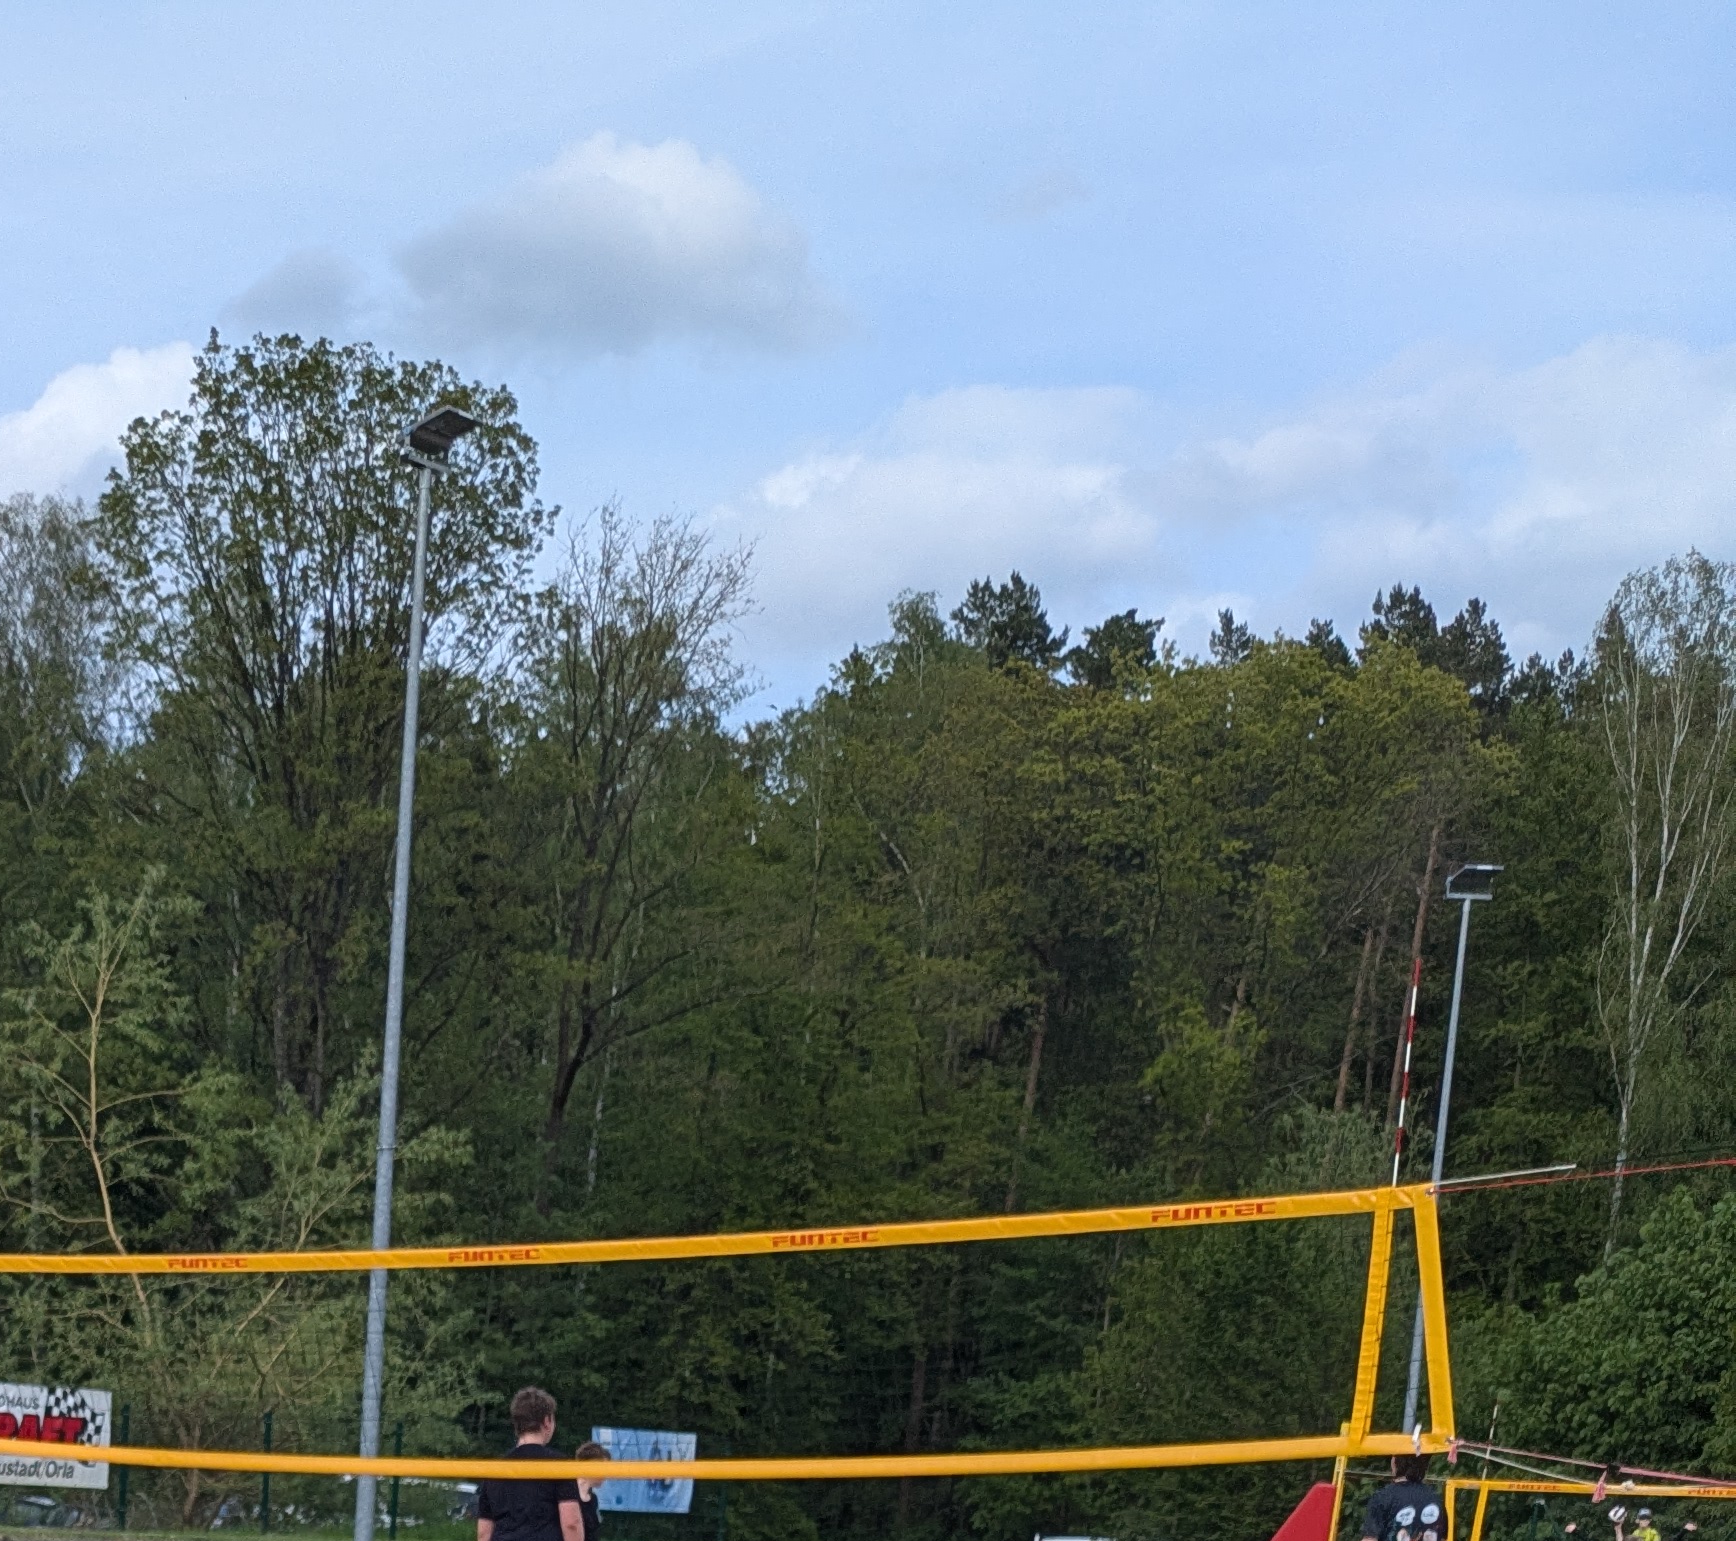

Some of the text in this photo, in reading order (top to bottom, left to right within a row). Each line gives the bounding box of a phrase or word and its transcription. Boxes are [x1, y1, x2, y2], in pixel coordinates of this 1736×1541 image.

[1151, 1200, 1276, 1224] FUNTEC
[772, 1230, 879, 1248] FUNTEC
[448, 1248, 541, 1263] FUNTEC
